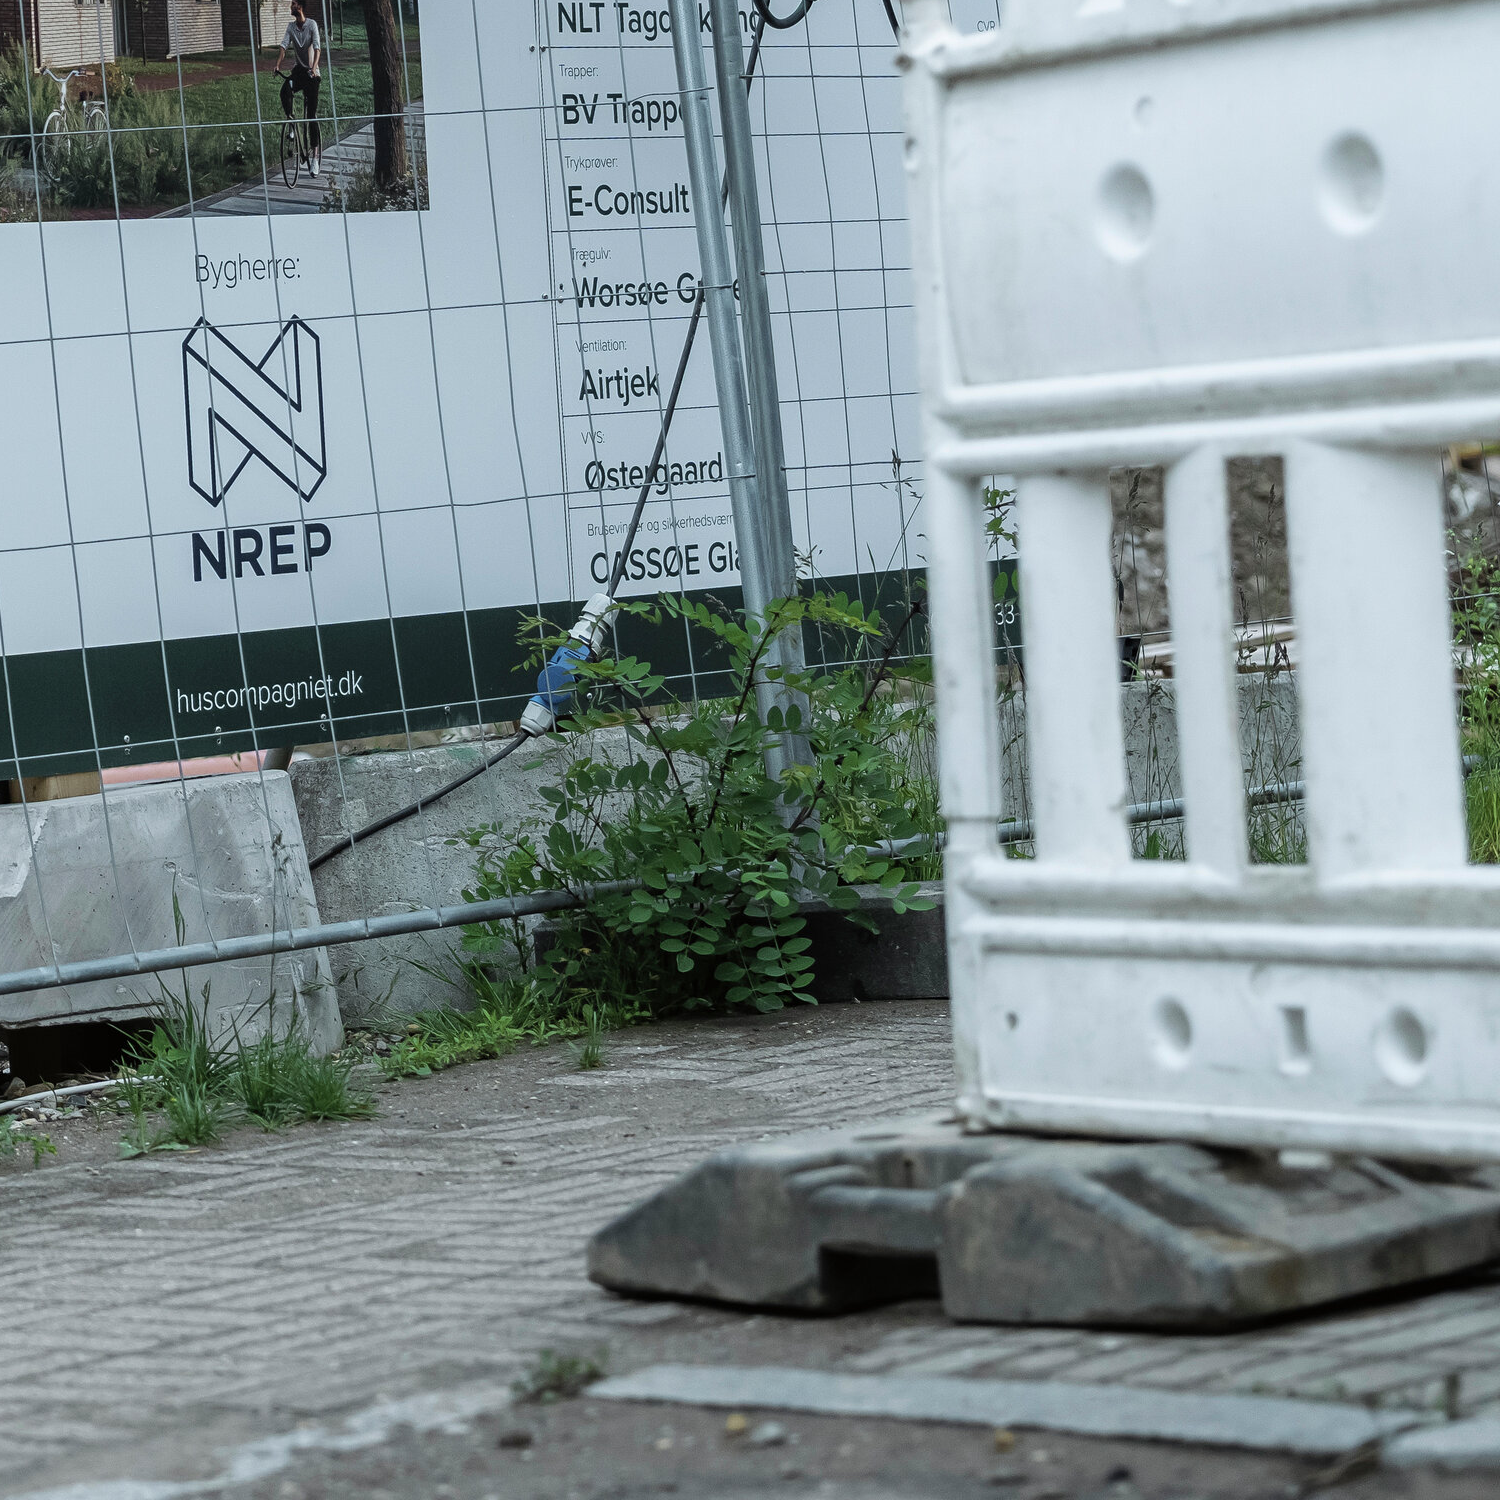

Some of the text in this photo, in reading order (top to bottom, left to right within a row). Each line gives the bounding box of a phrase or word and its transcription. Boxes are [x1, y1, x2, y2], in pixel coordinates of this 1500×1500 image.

[557, 2, 605, 33] NLT
[977, 20, 996, 32] CVR
[559, 64, 599, 79] Trapper:
[562, 92, 683, 131] BV Trapp
[565, 155, 618, 172] Trykprøver:
[568, 182, 690, 217] E-Consult
[571, 247, 612, 263] Trægulv:
[195, 253, 301, 289] Bygherre:
[572, 275, 668, 309] Worsøe
[575, 338, 627, 353] Ventilation:
[579, 365, 660, 406] Airtjek
[581, 430, 605, 445] VVS:
[646, 521, 660, 534] og
[191, 522, 332, 582] NREP
[177, 669, 364, 713] huscompagniet.dk
